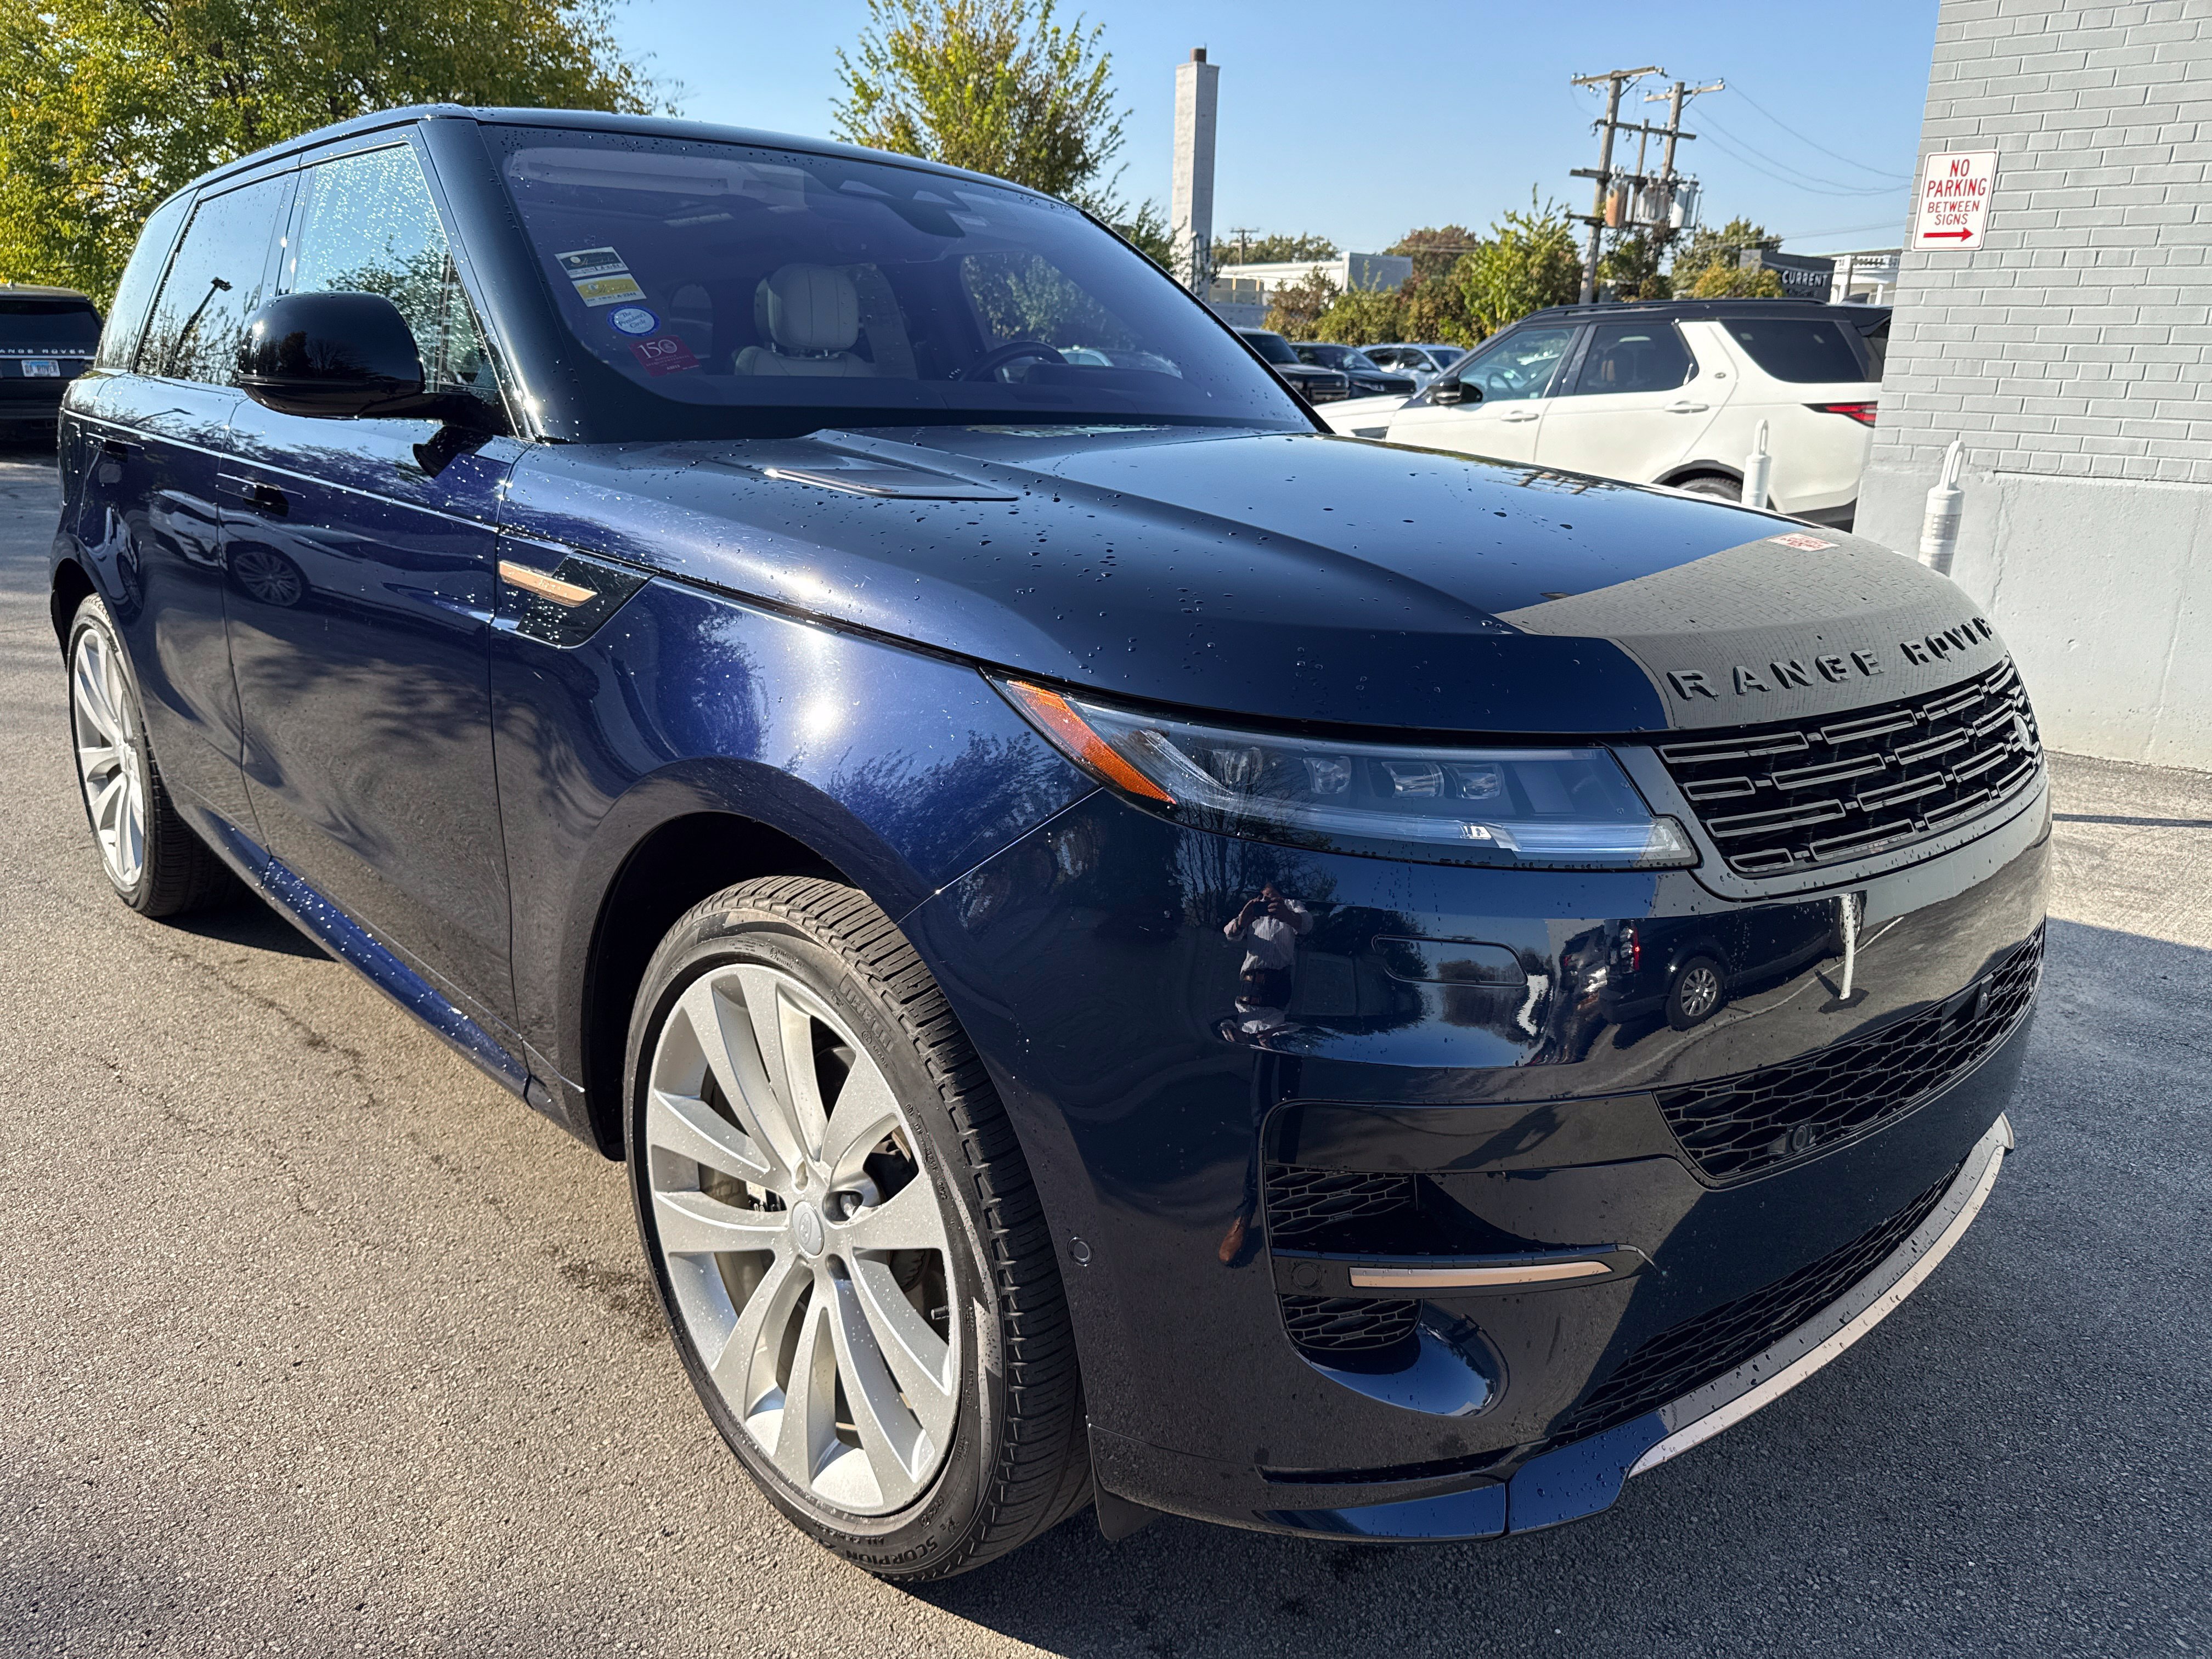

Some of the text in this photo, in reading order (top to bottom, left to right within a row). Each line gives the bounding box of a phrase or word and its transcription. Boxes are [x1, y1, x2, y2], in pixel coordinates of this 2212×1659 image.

[1949, 159, 1970, 177] NO
[1926, 178, 1988, 198] PARKING
[1927, 200, 1980, 213] BETWEEN
[1934, 213, 1968, 225] SIGNS
[1781, 269, 1828, 287] CURRENT
[637, 339, 678, 359] 150
[1667, 648, 1885, 702] RANGE
[846, 1534, 939, 1566] SCORPION
